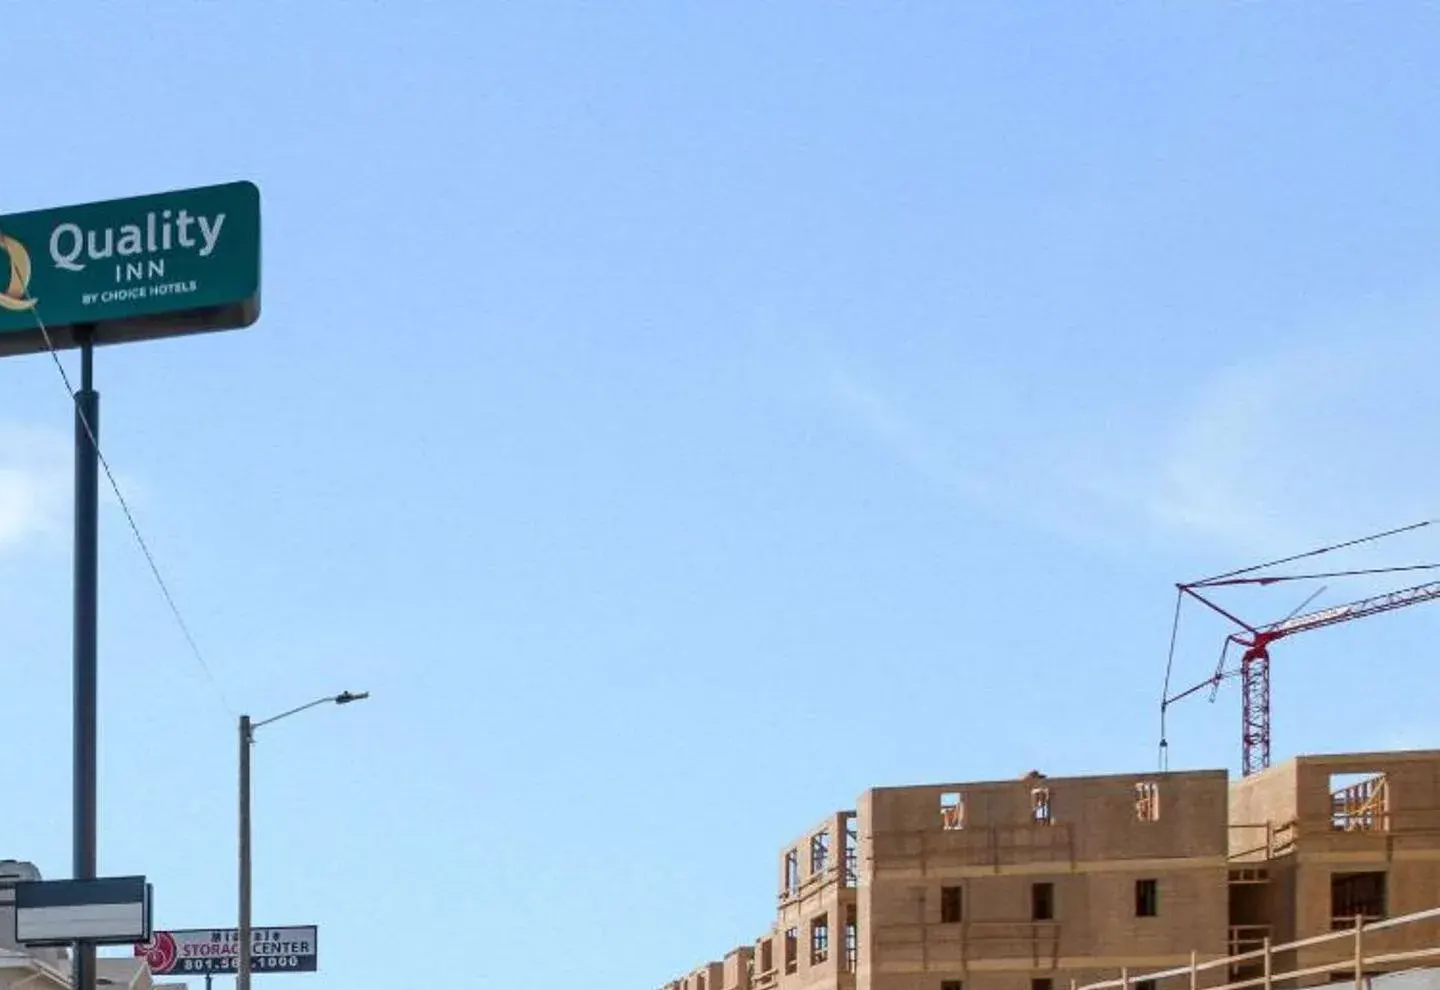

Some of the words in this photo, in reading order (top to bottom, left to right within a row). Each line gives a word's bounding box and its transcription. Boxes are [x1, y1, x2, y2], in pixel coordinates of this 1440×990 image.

[49, 210, 227, 271] Quality
[116, 258, 165, 283] INN
[82, 293, 99, 305] BY
[101, 286, 147, 303] CHOICE
[149, 280, 197, 297] HOTELS
[252, 940, 310, 955] CENTER
[183, 956, 299, 970] 801.56.1000
